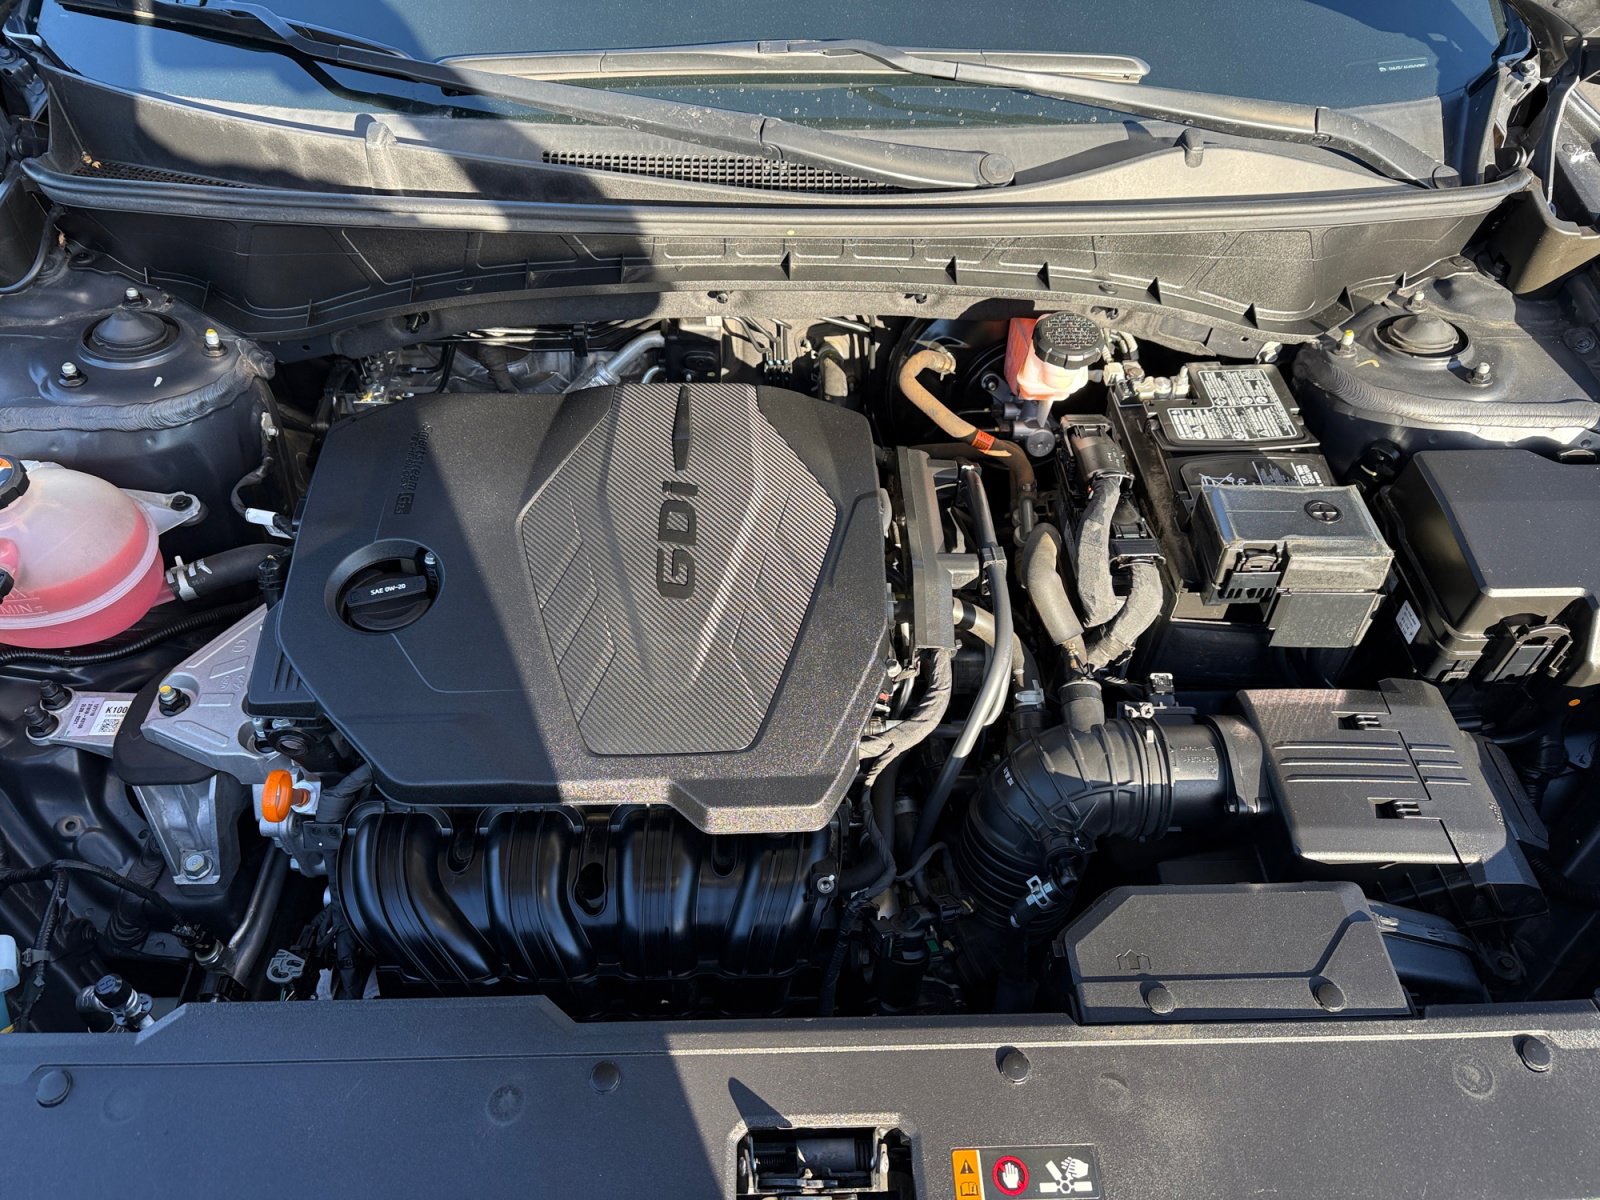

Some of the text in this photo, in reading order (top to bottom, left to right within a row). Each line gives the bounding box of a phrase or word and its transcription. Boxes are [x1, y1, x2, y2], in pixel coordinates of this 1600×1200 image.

[407, 421, 433, 491] Smartstream
[656, 480, 698, 600] GDi
[0, 603, 33, 615] MIN
[370, 583, 406, 596] SAE 0W-20
